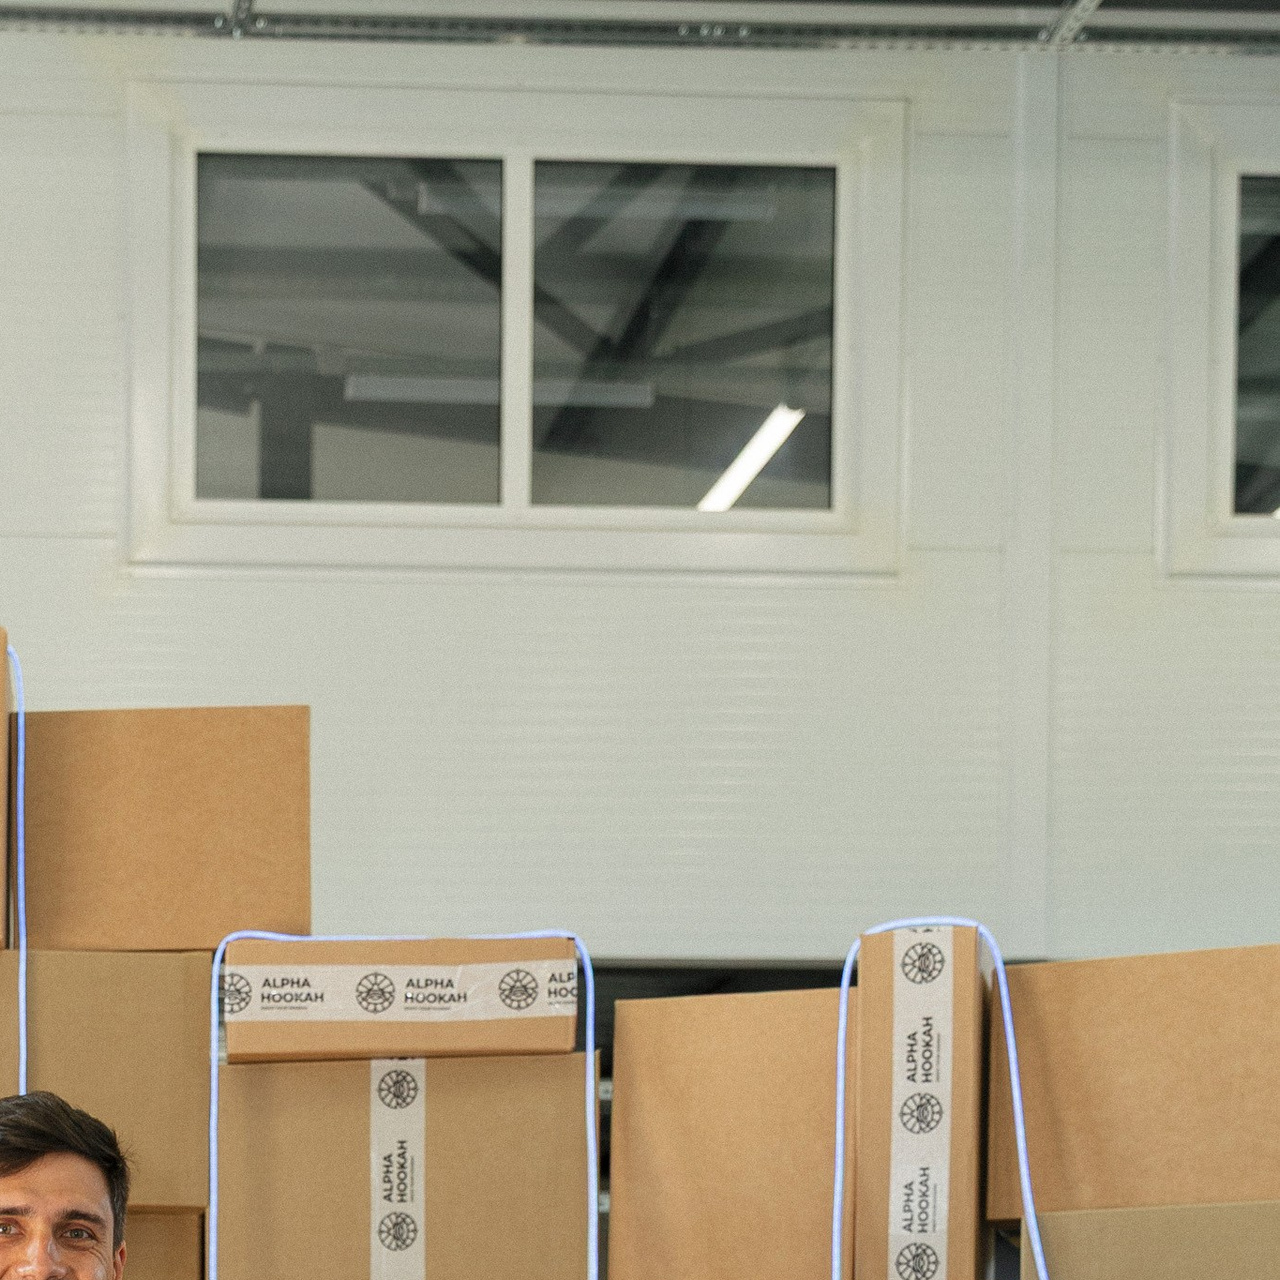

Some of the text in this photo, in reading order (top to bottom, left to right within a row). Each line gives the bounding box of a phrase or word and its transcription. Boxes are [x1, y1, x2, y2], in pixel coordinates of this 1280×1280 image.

[260, 991, 325, 1004] HOOKAH
[261, 978, 311, 990] ALPHA
[404, 991, 468, 1004] HOOKAH
[405, 978, 455, 990] ALPHA
[907, 1030, 918, 1084] ALPHA
[922, 1016, 934, 1084] HOOKAH
[383, 1153, 394, 1203] ALPHA
[397, 1139, 408, 1204] HOOKAH
[902, 1180, 915, 1233] ALPHA
[917, 1166, 930, 1234] HOOKAH
